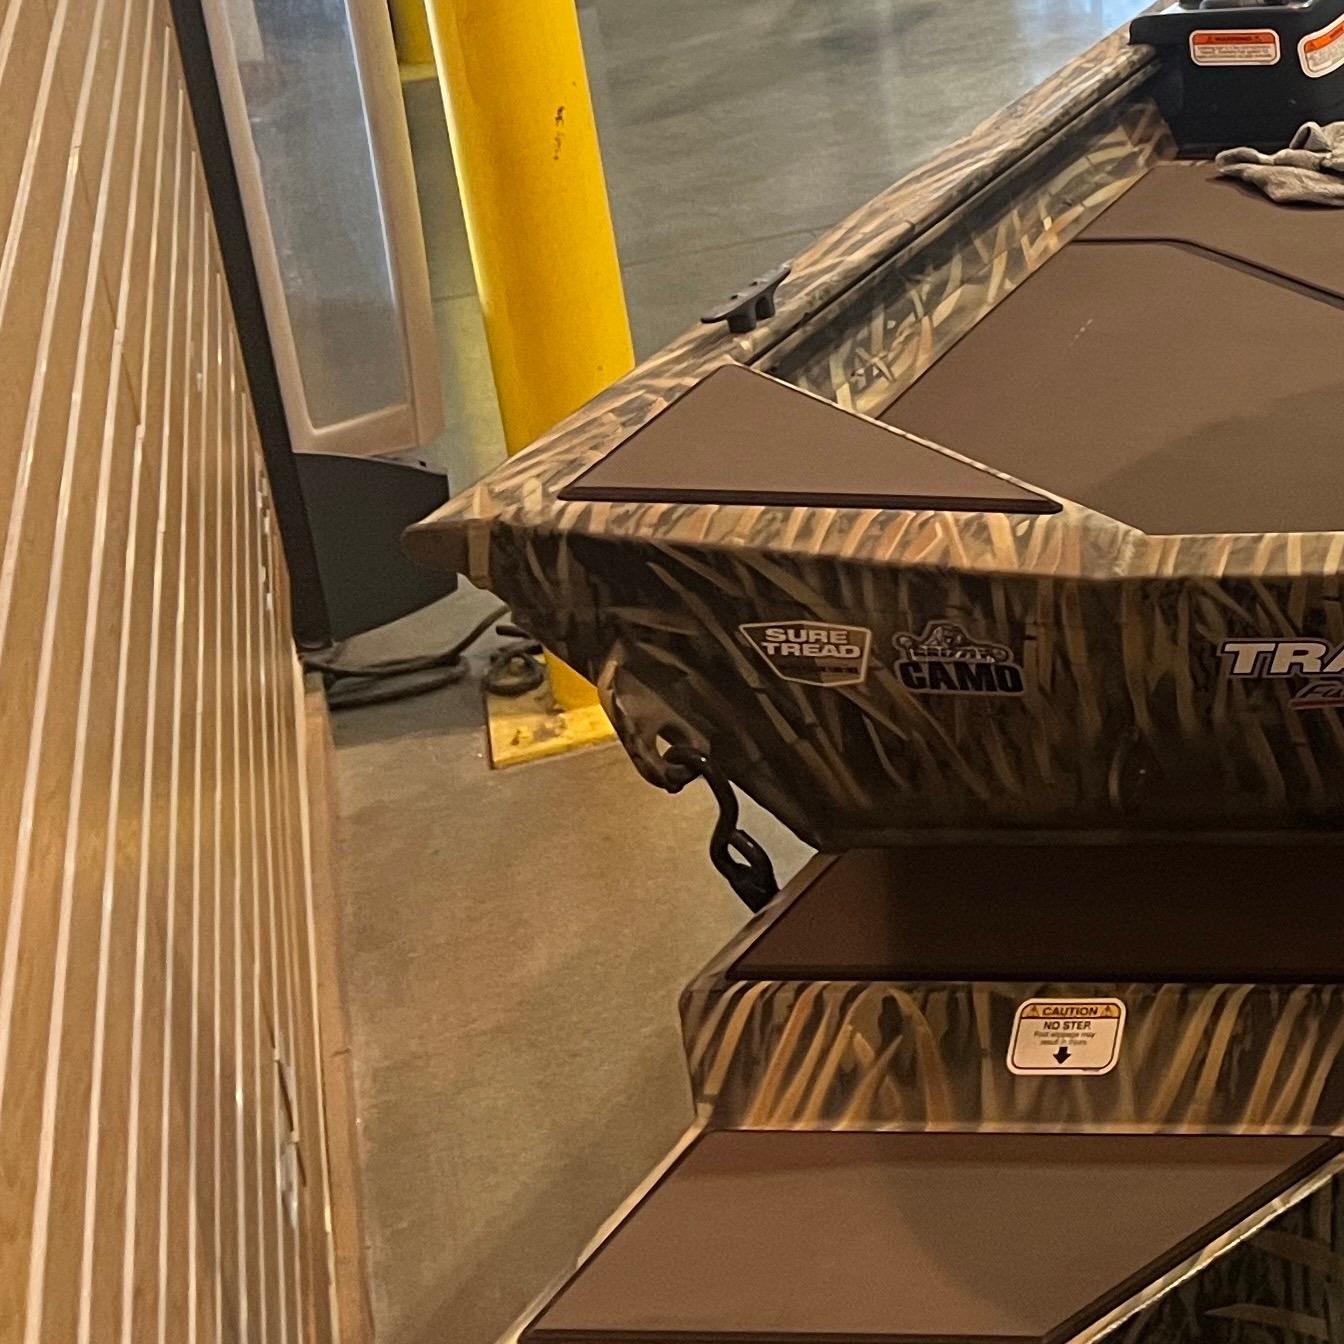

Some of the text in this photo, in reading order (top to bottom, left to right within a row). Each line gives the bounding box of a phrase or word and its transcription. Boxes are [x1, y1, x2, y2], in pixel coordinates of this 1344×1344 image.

[764, 627, 849, 644] SURE
[761, 641, 862, 658] TREAD
[899, 661, 1024, 693] CAMO
[1042, 1006, 1099, 1017] CAUTION
[1043, 1020, 1061, 1031] NO
